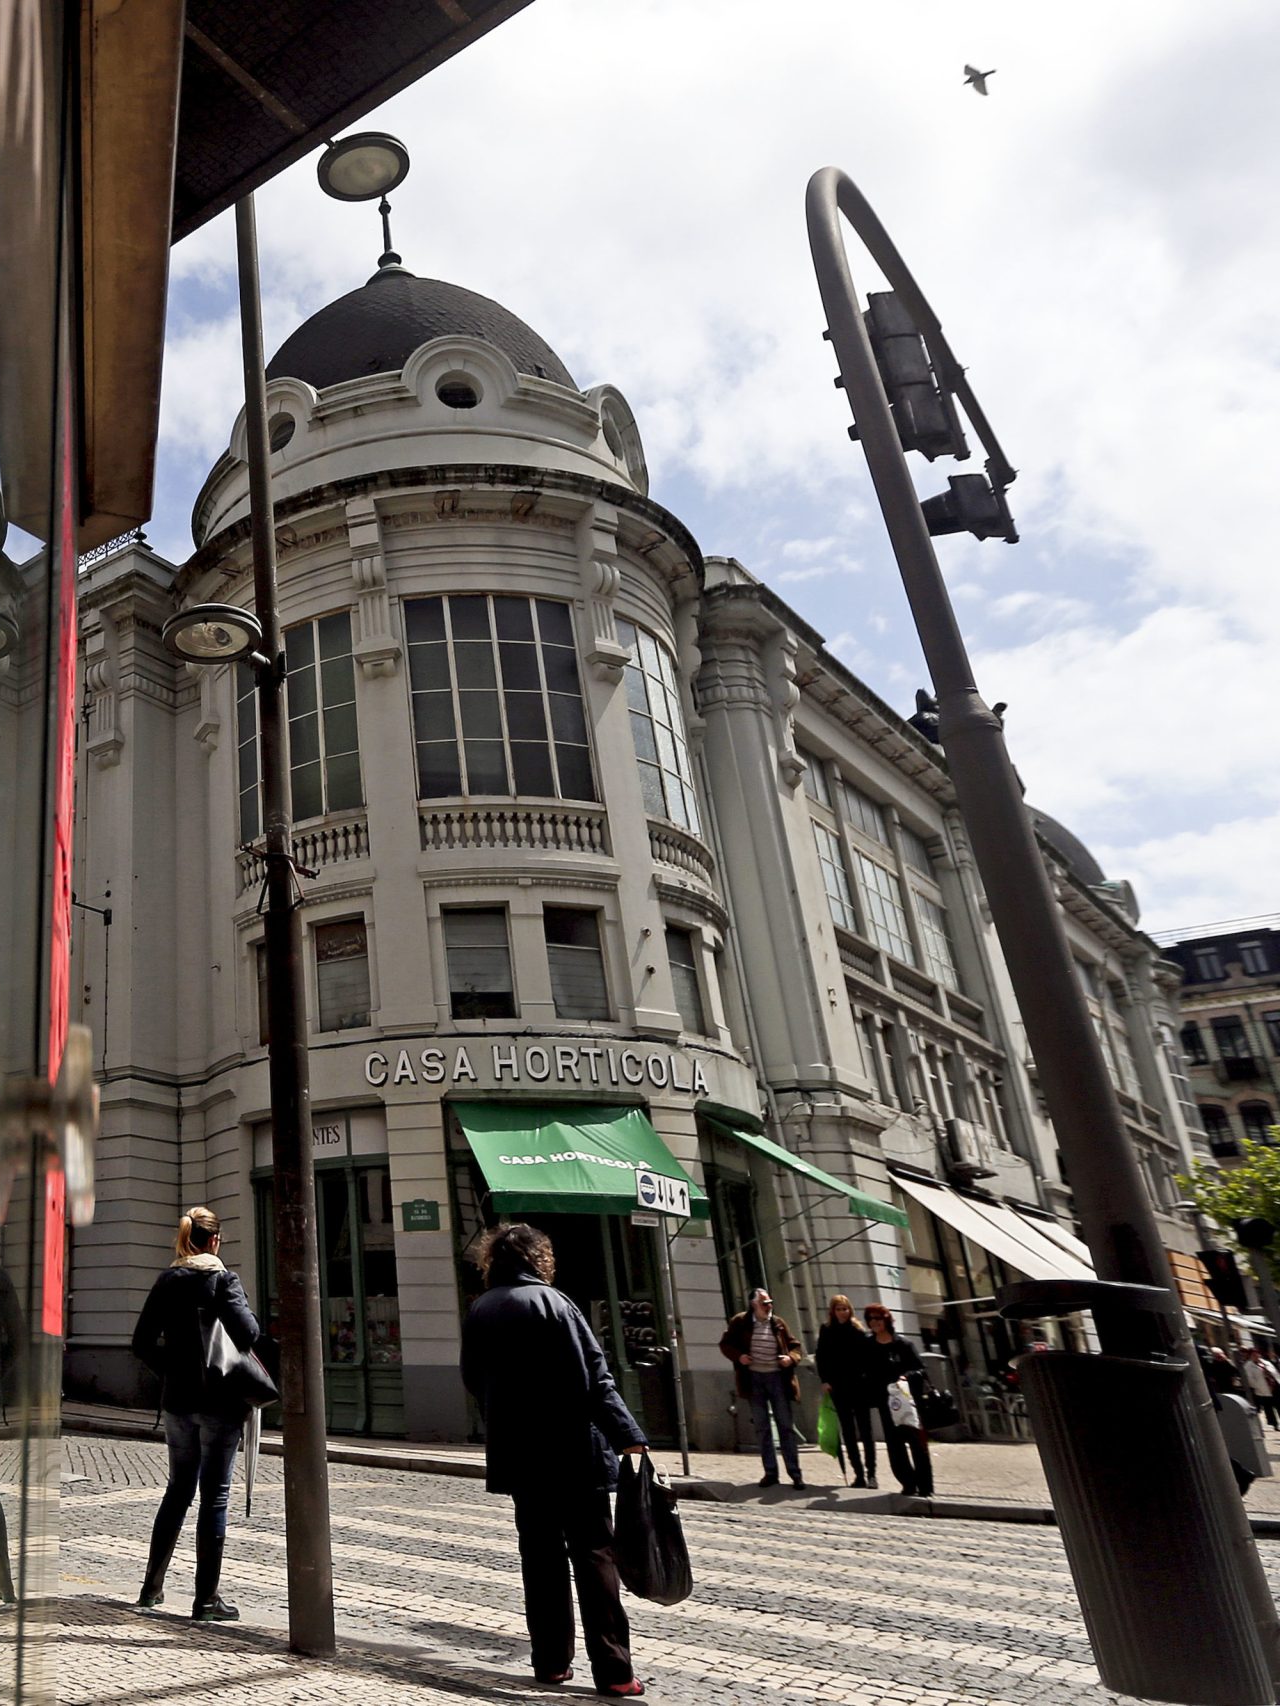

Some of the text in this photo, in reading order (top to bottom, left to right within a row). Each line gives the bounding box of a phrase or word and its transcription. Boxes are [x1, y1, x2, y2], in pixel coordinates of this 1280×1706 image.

[364, 1045, 710, 1094] CASA HORTICOLA
[498, 1150, 653, 1171] CASA HORTICOLA
